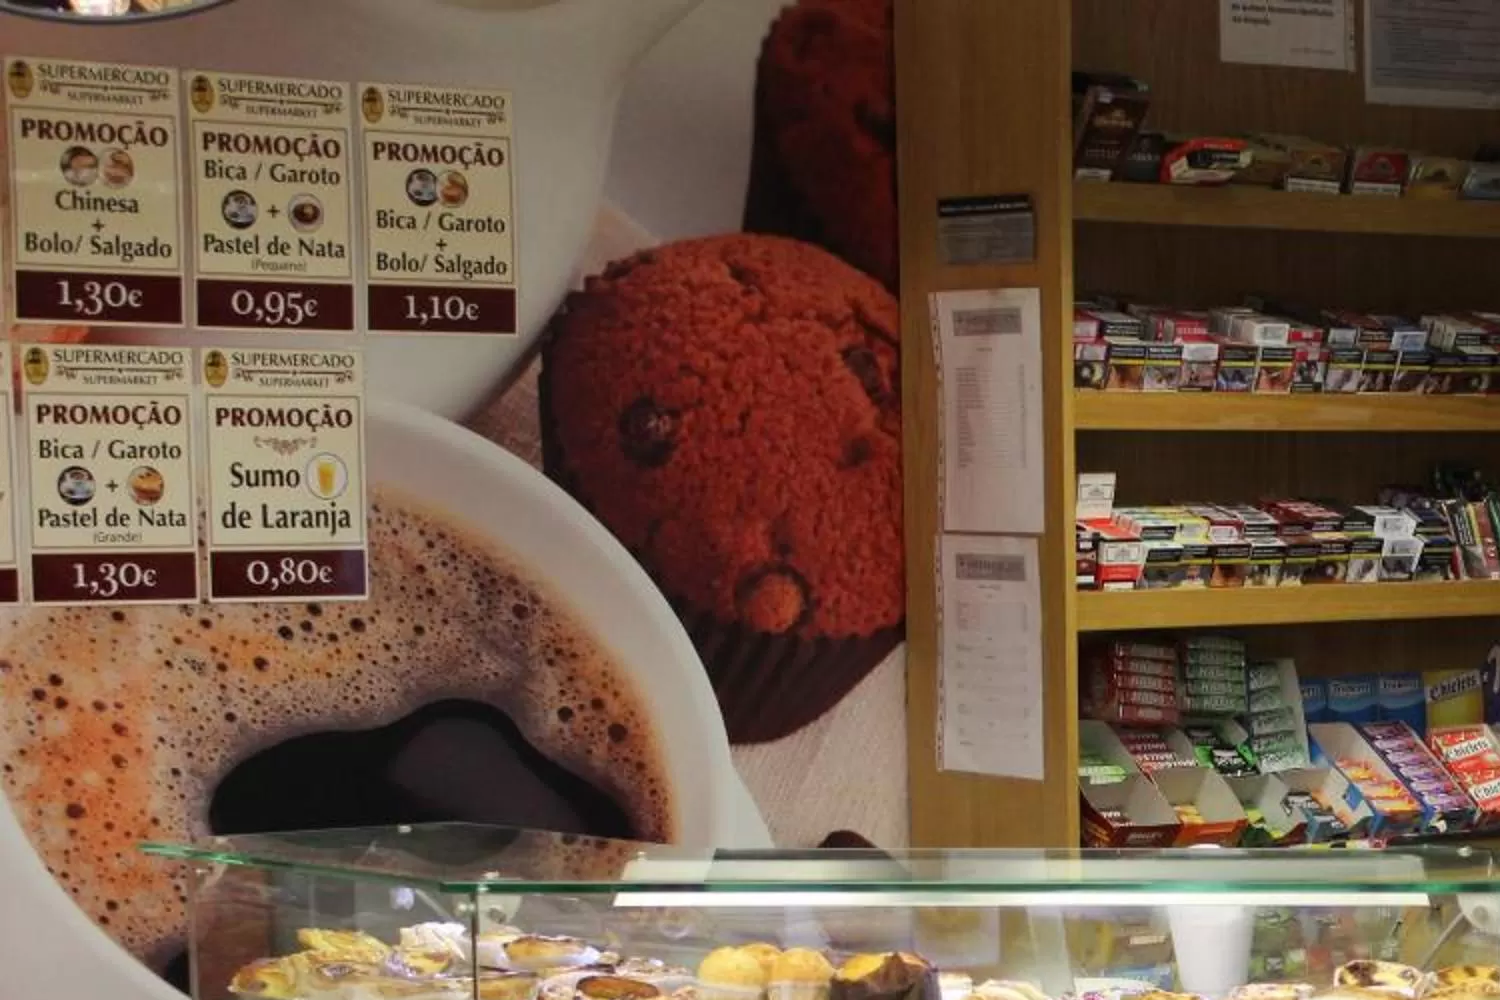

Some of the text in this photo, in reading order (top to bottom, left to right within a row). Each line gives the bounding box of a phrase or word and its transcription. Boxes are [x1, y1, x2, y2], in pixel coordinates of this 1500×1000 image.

[37, 63, 171, 86] SUPERMERCADO
[217, 77, 343, 99] SUPERMERCADO
[387, 89, 506, 110] SUPERMERCADO
[20, 117, 169, 147] PROMOÇÃO
[202, 131, 341, 161] PROMOÇÃO
[372, 142, 505, 171] PROMOÇÃO
[203, 159, 248, 181] Bica
[269, 162, 341, 185] Garoto
[55, 191, 139, 215] Chinesa
[375, 209, 418, 231] Bica
[438, 212, 506, 235] Garoto
[24, 232, 172, 262] Bolo/ Salgado
[203, 234, 346, 260] Pastel de Nata
[375, 253, 507, 280] Bolo/ Salgado
[57, 279, 144, 315] 1,30€
[231, 290, 318, 325] 0,95€
[405, 293, 480, 323] 1,10€
[52, 349, 184, 366] SUPERMERCADO
[231, 352, 355, 369] SUPERMERCADO
[82, 375, 158, 386] SUPERMARKET
[36, 401, 182, 431] PROMOÇÃO
[215, 404, 353, 432] PROMOÇÃO
[38, 438, 85, 460] Bica
[108, 440, 182, 461] Garoto
[229, 461, 301, 490] Sumo
[38, 508, 186, 528] Pastel de Nata
[221, 503, 352, 536] de Laranja
[73, 562, 157, 598] 1,30€
[246, 559, 334, 594] 0,80€
